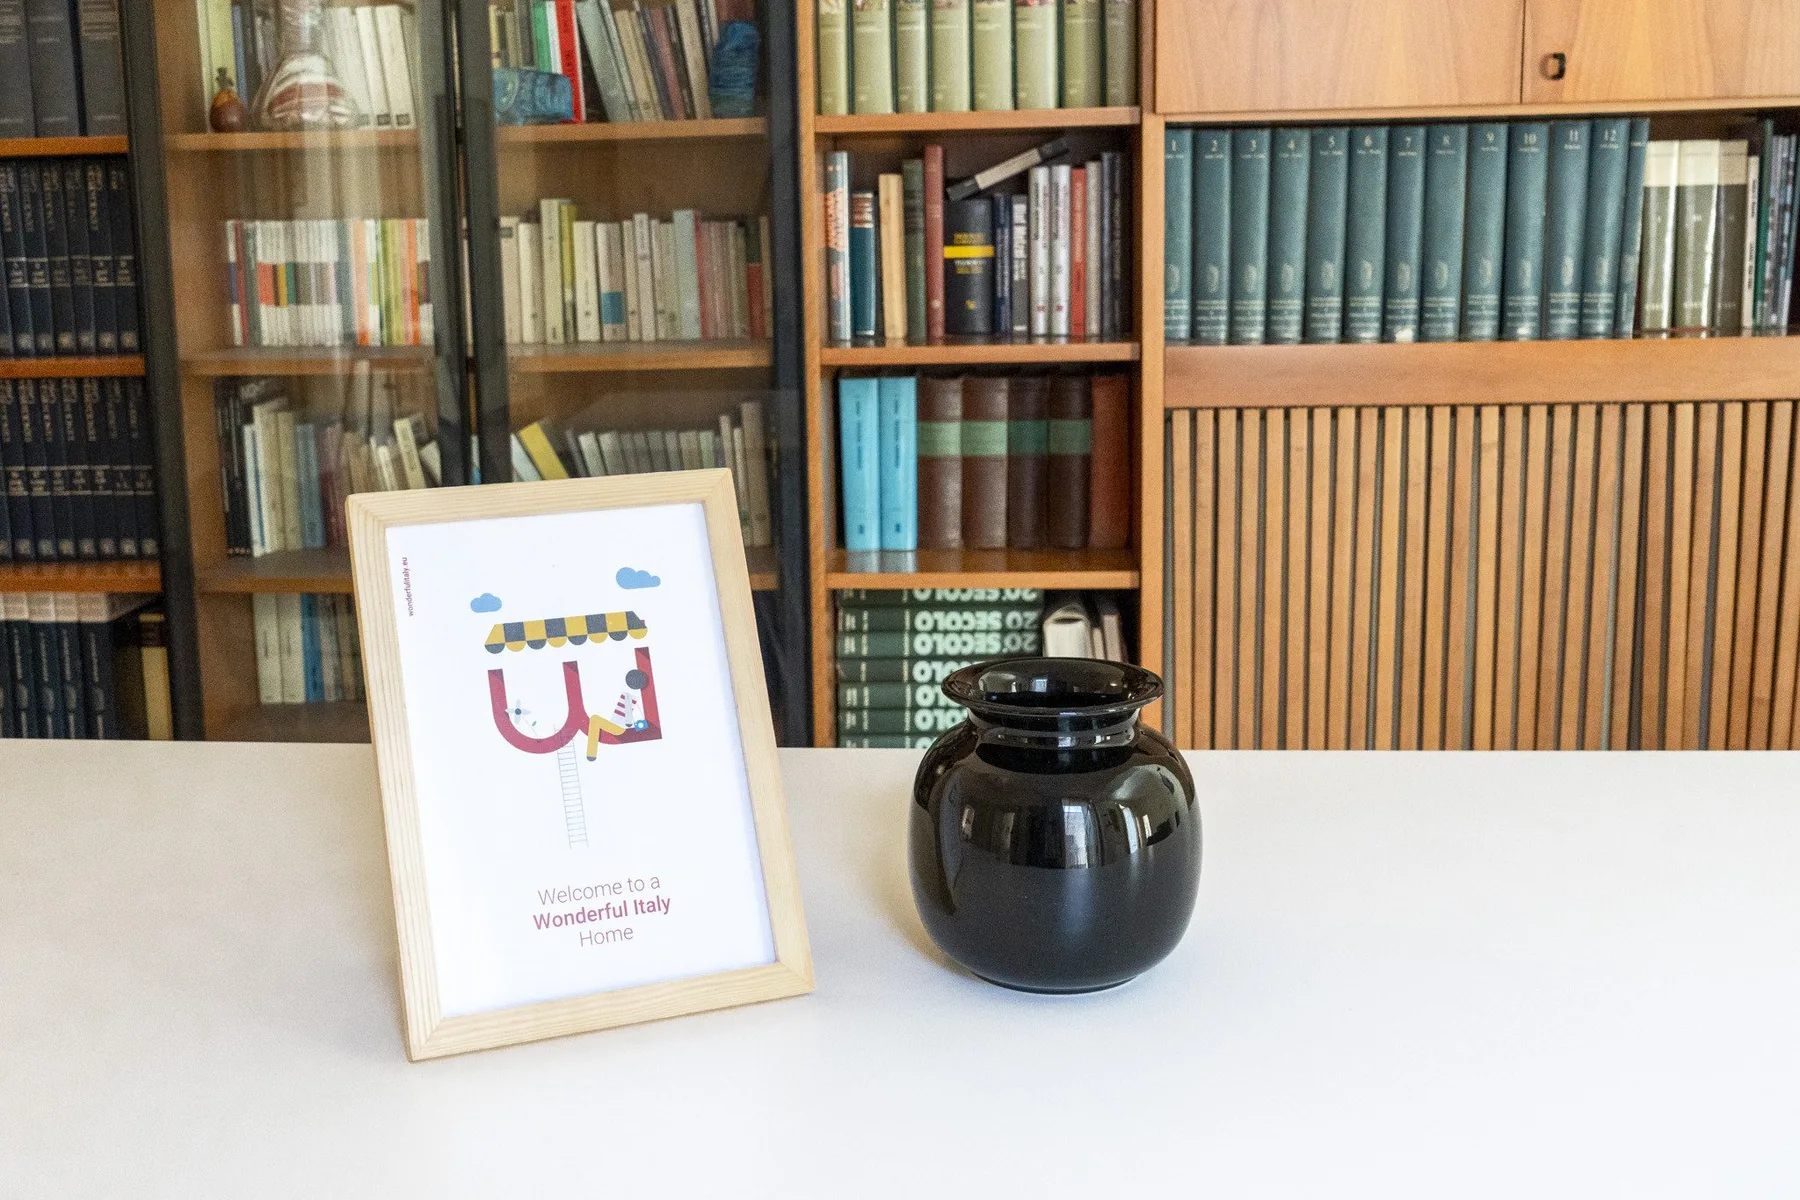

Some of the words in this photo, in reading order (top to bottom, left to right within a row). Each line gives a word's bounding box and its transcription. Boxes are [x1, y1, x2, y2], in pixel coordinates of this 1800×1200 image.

[1524, 132, 1537, 144] 10
[402, 556, 414, 617] wonderfulitaly.eu
[914, 610, 1002, 632] SECOLO
[913, 632, 1002, 656] SECOLO
[538, 882, 623, 905] Welcome
[627, 878, 645, 893] to
[650, 876, 661, 889] a
[533, 900, 628, 930] Wonderful
[634, 895, 671, 915] Italy
[579, 927, 634, 947] Home
